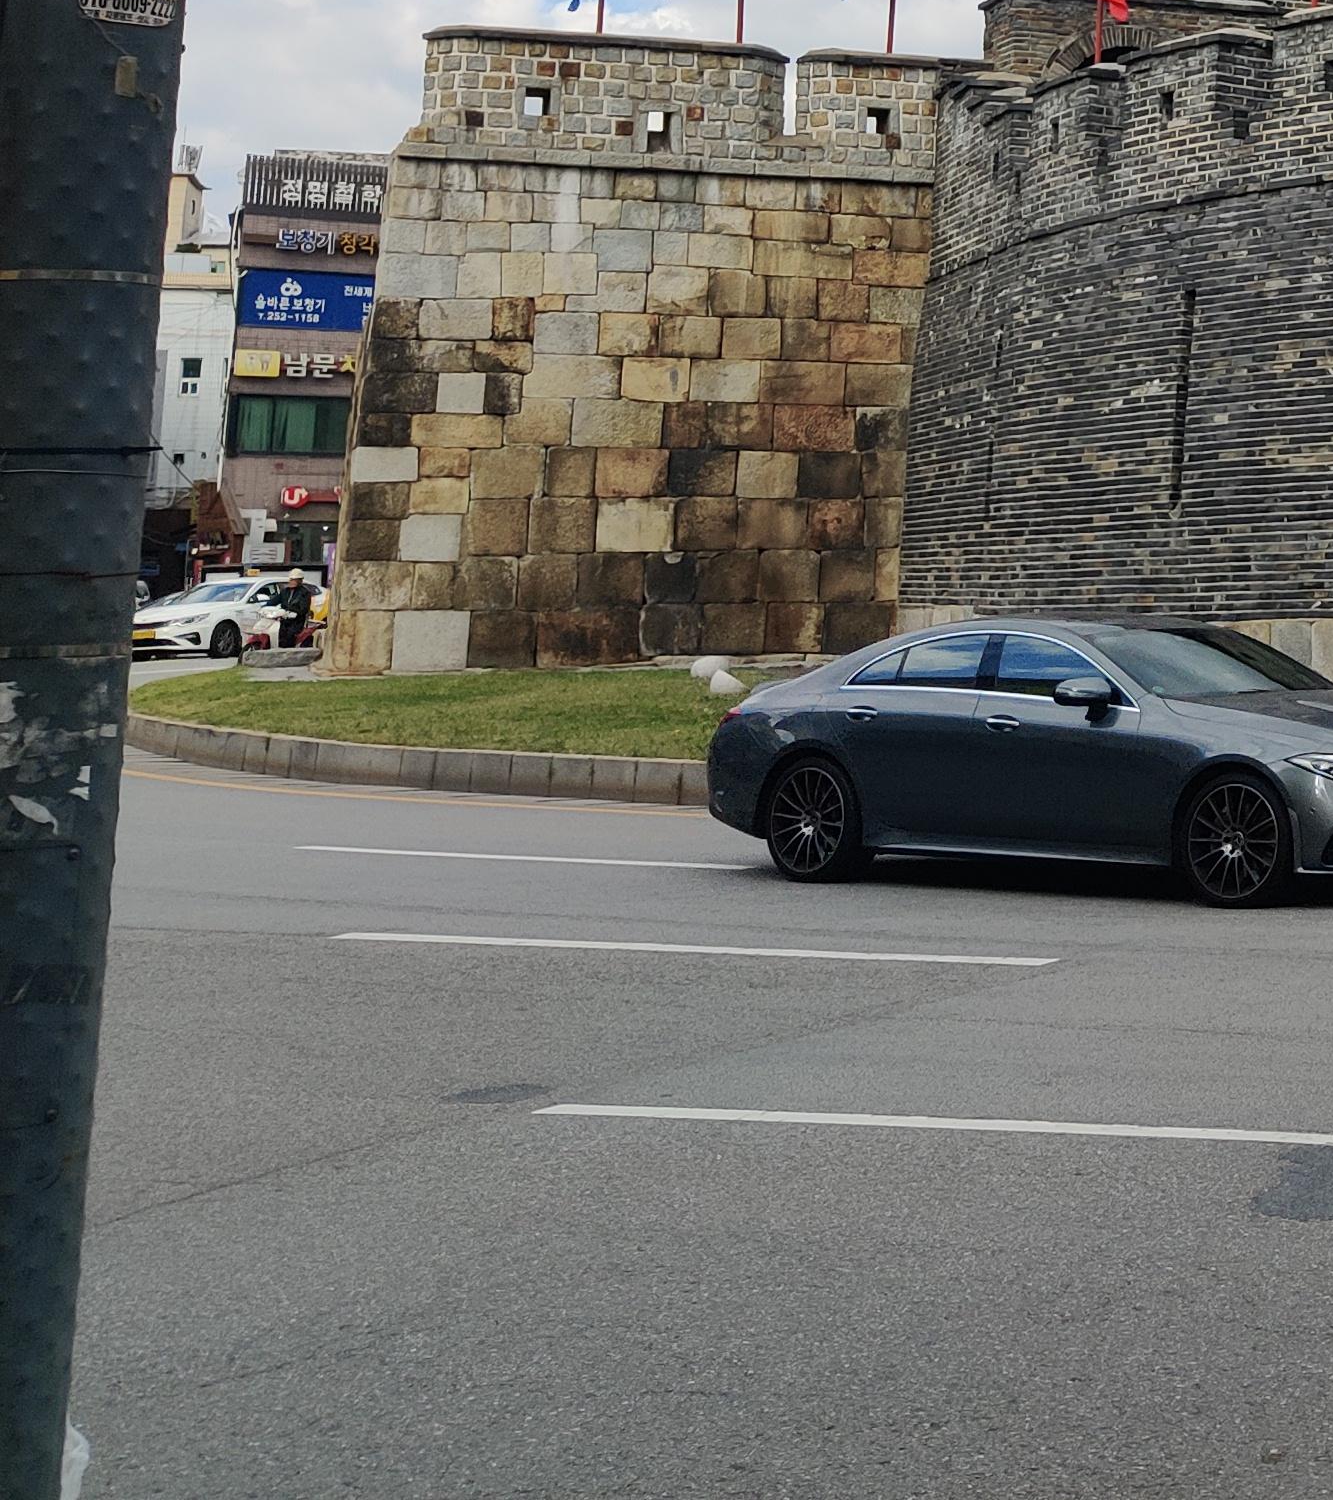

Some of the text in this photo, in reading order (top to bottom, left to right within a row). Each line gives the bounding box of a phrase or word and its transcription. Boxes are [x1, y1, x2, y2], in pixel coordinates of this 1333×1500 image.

[276, 228, 377, 256] 보청기 청각
[255, 293, 326, 313] 올바른 보청기
